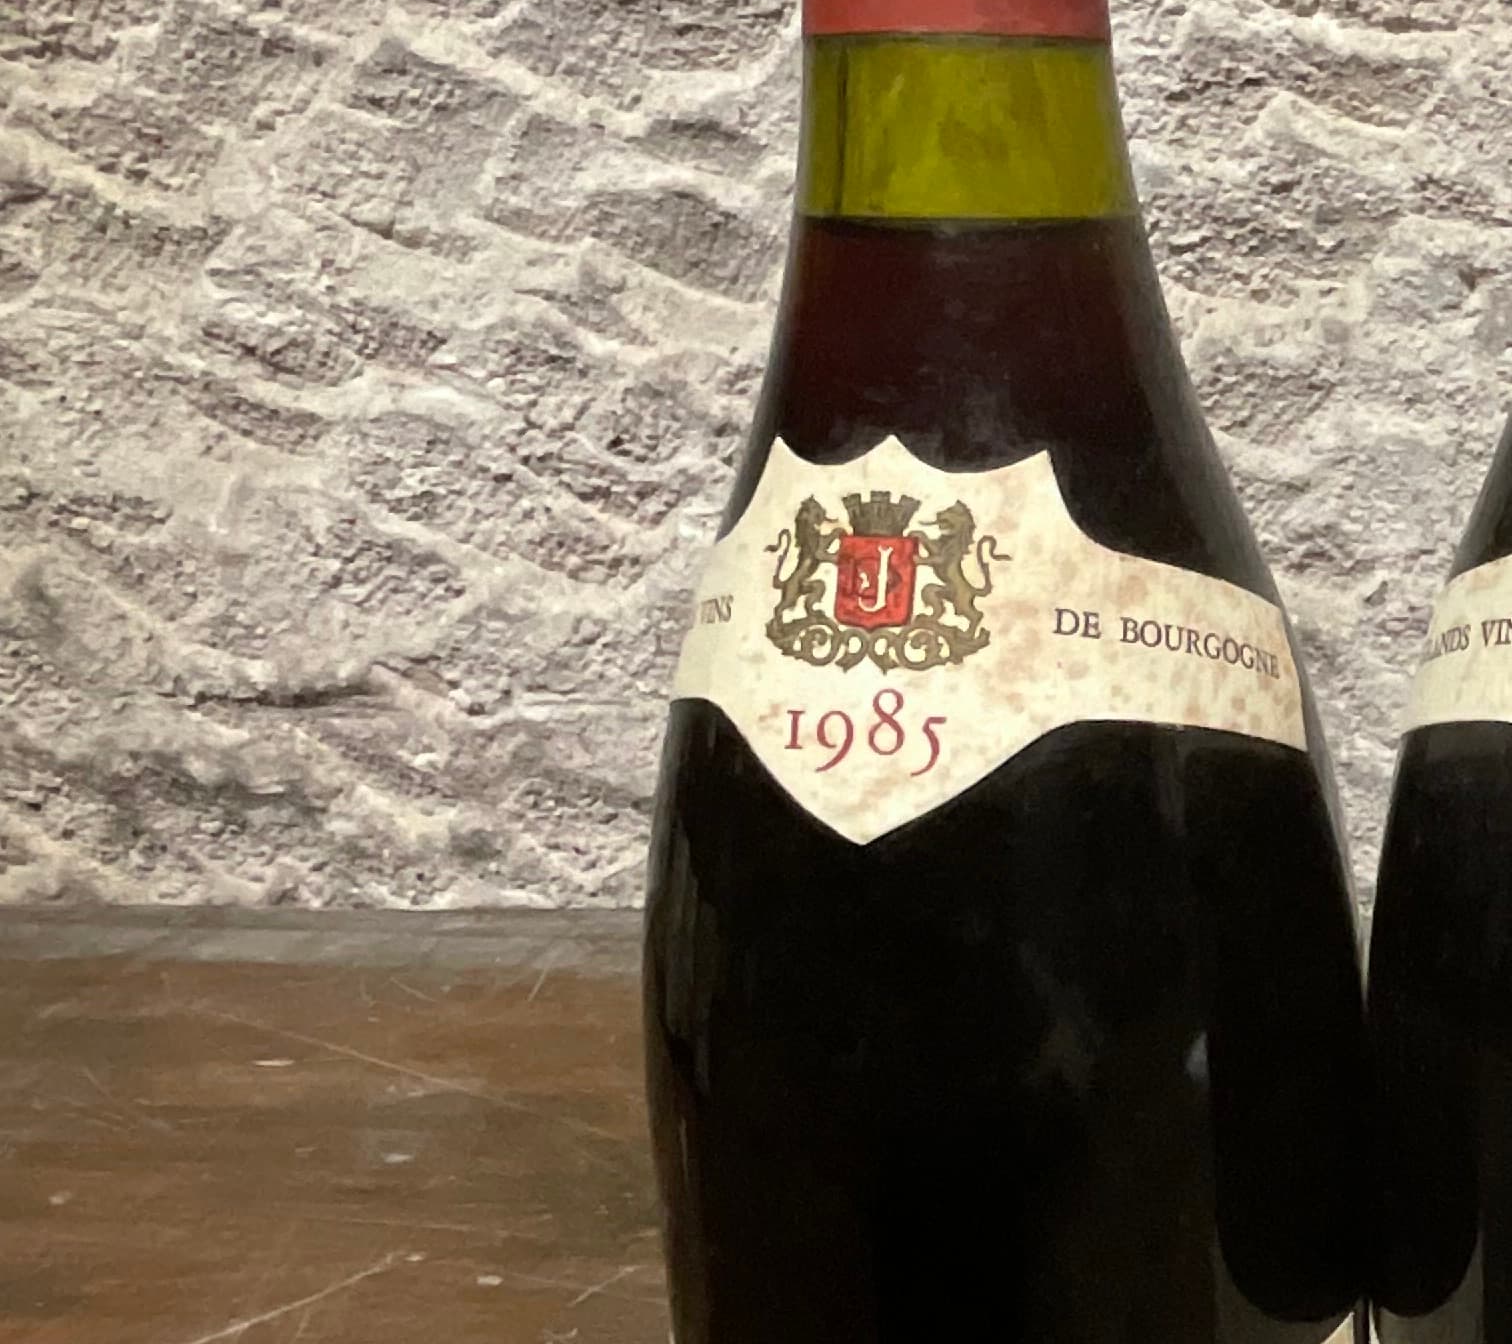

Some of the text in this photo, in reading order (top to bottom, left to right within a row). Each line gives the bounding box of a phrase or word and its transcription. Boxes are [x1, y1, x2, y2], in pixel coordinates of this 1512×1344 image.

[1052, 607, 1102, 639] DE
[1119, 616, 1281, 679] BOURGOGNE
[783, 687, 948, 777] 1985
